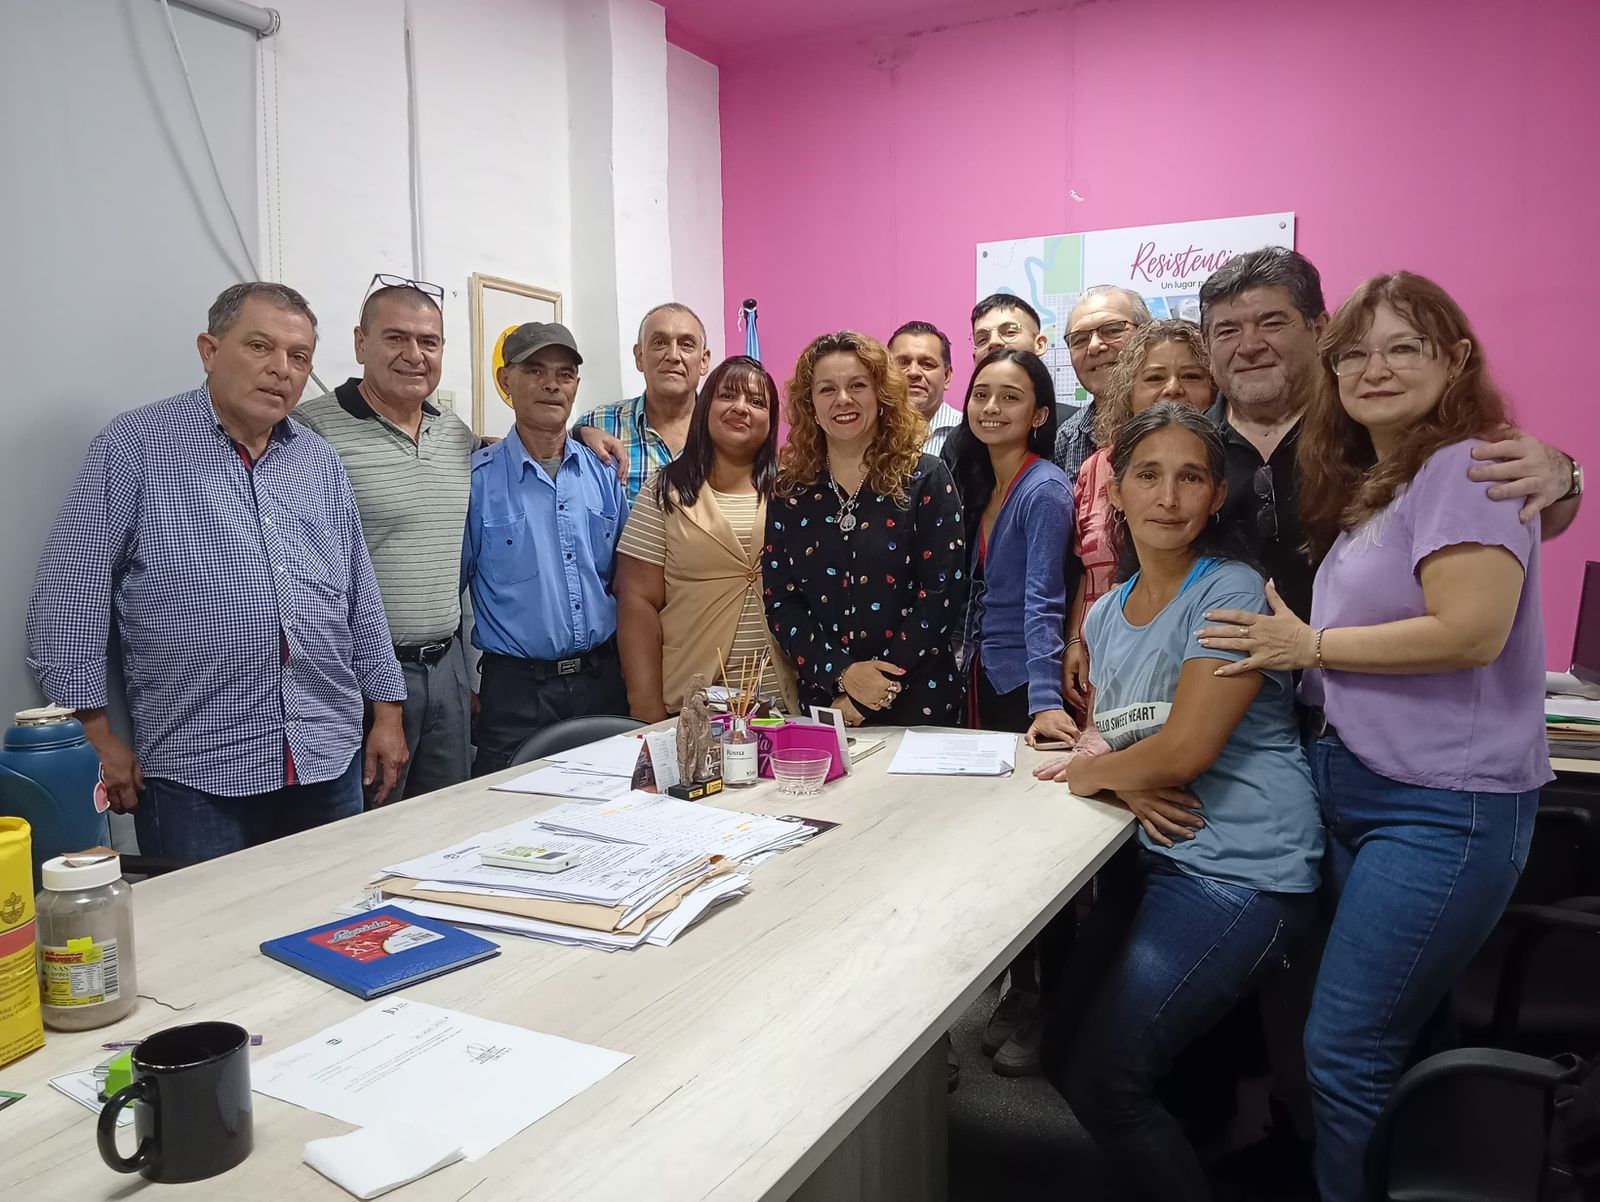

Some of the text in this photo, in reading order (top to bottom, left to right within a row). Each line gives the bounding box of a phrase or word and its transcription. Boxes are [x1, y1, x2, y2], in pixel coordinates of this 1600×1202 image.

[1131, 241, 1233, 282] Resistenci
[1160, 281, 1173, 290] Un
[1174, 280, 1196, 290] lugar
[1110, 711, 1128, 730] SWEET
